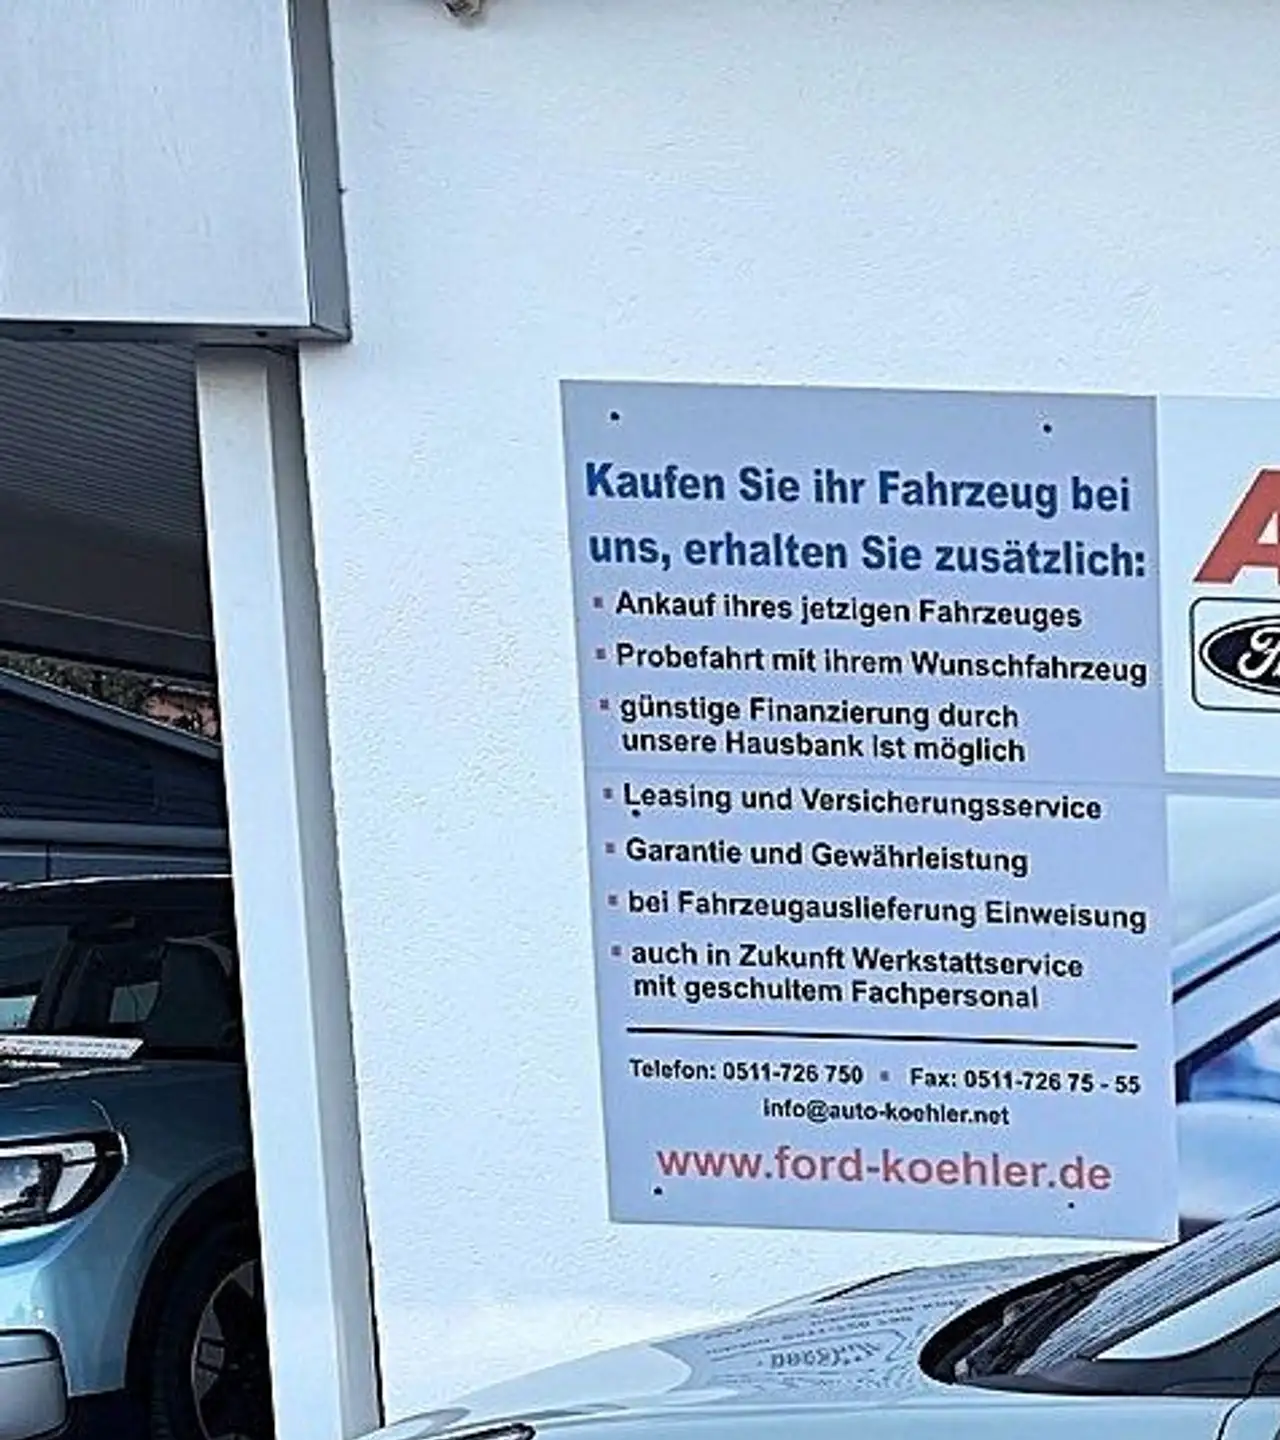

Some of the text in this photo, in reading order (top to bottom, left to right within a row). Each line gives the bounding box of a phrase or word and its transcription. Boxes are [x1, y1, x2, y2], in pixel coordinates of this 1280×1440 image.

[587, 463, 1128, 519] Kaufen Sie ihr Fahrzeug bei
[590, 532, 1144, 576] uns, erhalten Sie zusätzlich:
[616, 591, 1082, 632] Ankauf ihres jetzigen Fahrzeuges
[617, 643, 1146, 687] Probefahrt mit ihrem Wunschfahrzeug
[620, 694, 1017, 731] günstige Finanzierung durch
[622, 734, 716, 753] unsere
[727, 730, 864, 756] Hausbank
[915, 737, 1025, 766] möglich
[624, 783, 1100, 821] Leasing und Versicherungsservice
[627, 837, 1027, 877] Garantie und Gewährleistung
[629, 890, 1146, 934] bei Fahrzeugauslieferung Einweisung
[632, 942, 1082, 977] auch in Zukunft Werkstattservice
[635, 974, 1037, 1009] mit geschultem Fachpersonal
[629, 1059, 716, 1079] Telefon:
[724, 1062, 818, 1082] 0511-726
[825, 1065, 863, 1084] 750
[911, 1068, 956, 1087] Fax:
[965, 1070, 1061, 1091] 0511-726
[1068, 1073, 1093, 1092] 75
[1116, 1076, 1140, 1094] 55
[657, 1146, 1111, 1190] www.ford-koehler.de
